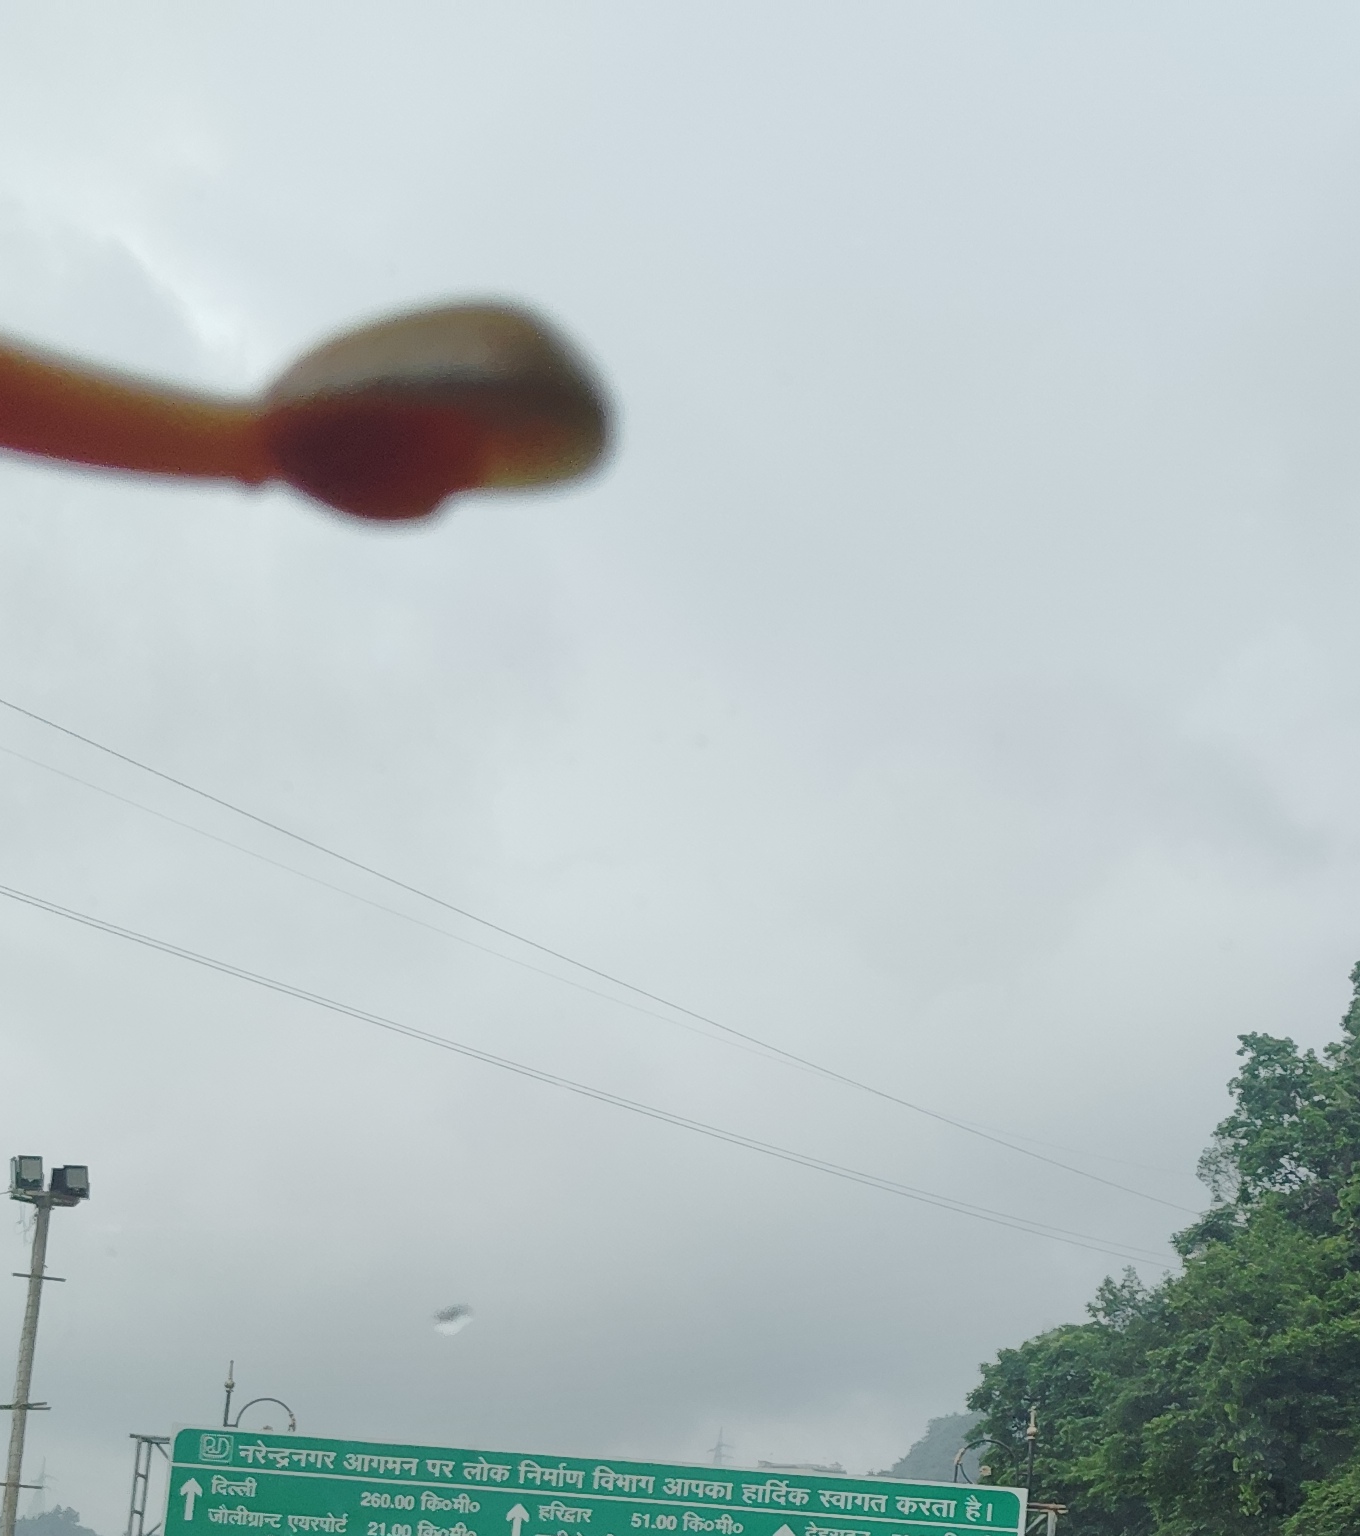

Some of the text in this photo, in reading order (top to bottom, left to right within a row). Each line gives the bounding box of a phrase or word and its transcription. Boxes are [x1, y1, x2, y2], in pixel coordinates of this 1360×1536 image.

[211, 1474, 258, 1498] दिल्ली
[360, 1491, 415, 1511] 260.00
[238, 1440, 337, 1469] नरेन्द्रनगर
[343, 1453, 419, 1478] आगमन
[425, 1459, 456, 1478] पर
[463, 1456, 513, 1483] लोक
[518, 1459, 586, 1489] निर्माण
[593, 1465, 656, 1493] विभाग
[662, 1477, 734, 1501] आपका
[742, 1479, 811, 1507] हार्दिक
[817, 1489, 889, 1513] स्वागत
[895, 1496, 957, 1518] करता
[287, 1512, 349, 1534] एयरपोर्ट
[538, 1500, 593, 1524] हरिद्वार
[631, 1512, 678, 1531] 51.00
